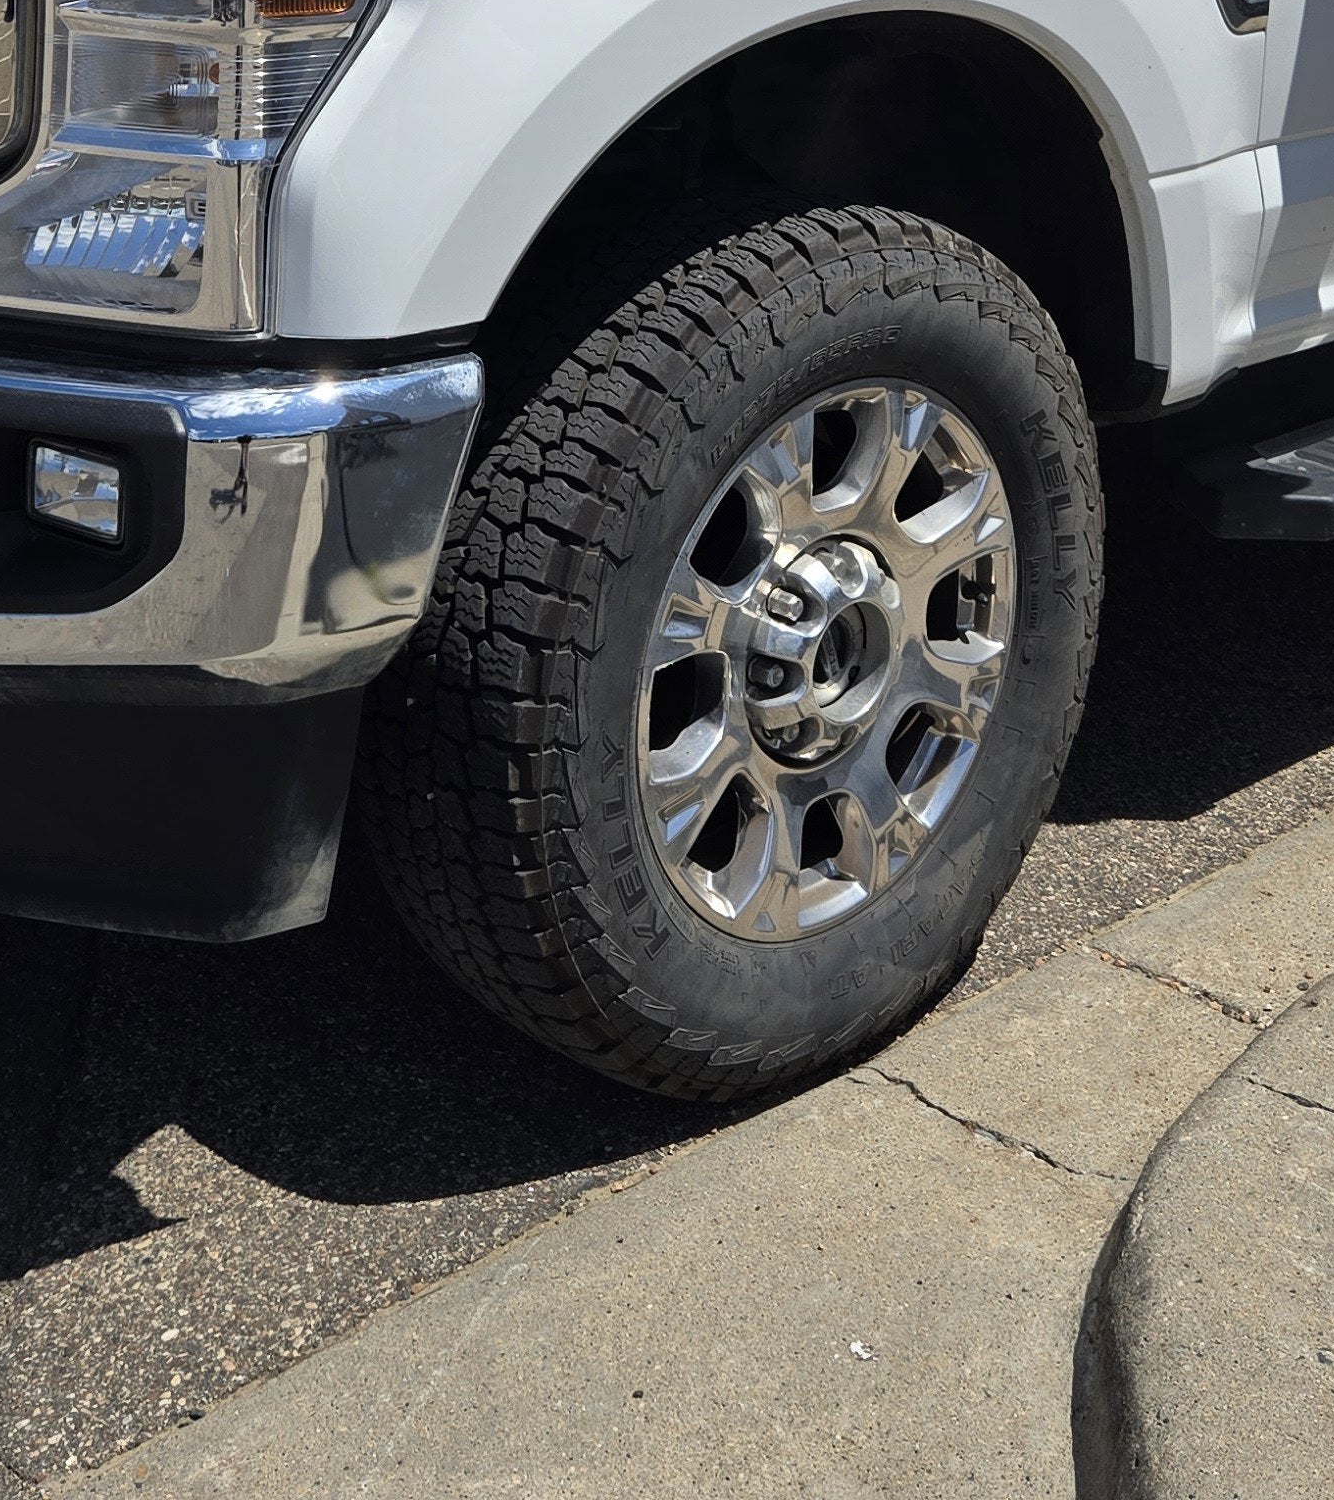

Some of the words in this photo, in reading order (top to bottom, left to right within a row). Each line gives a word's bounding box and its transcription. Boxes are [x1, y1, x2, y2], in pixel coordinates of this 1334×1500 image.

[1020, 408, 1078, 611] KELLY
[602, 729, 671, 960] KELLY
[890, 843, 986, 966] SAFARI
